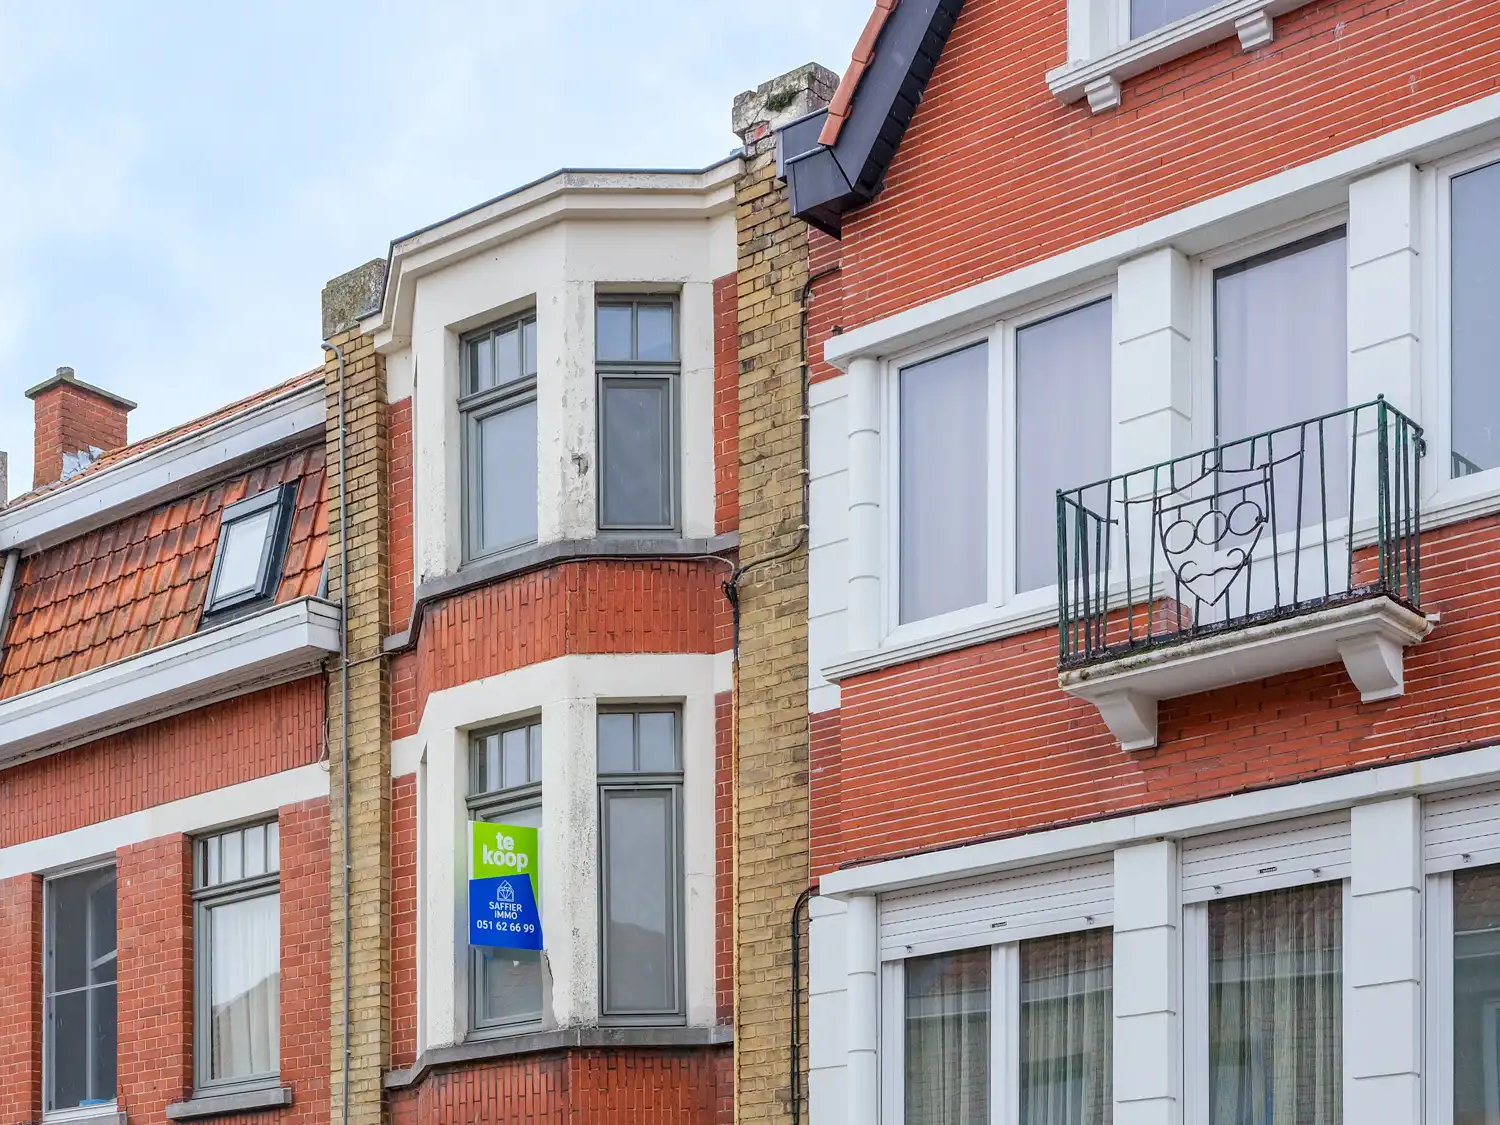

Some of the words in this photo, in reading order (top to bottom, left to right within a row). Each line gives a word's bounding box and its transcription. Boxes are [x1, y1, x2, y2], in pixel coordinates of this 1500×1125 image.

[496, 832, 514, 850] te
[483, 844, 528, 872] koop
[489, 901, 522, 912] SAFFIER
[494, 910, 517, 919] IMMO
[477, 920, 492, 930] 051
[496, 921, 507, 931] 62
[510, 923, 520, 932] 66
[523, 923, 534, 933] 99
